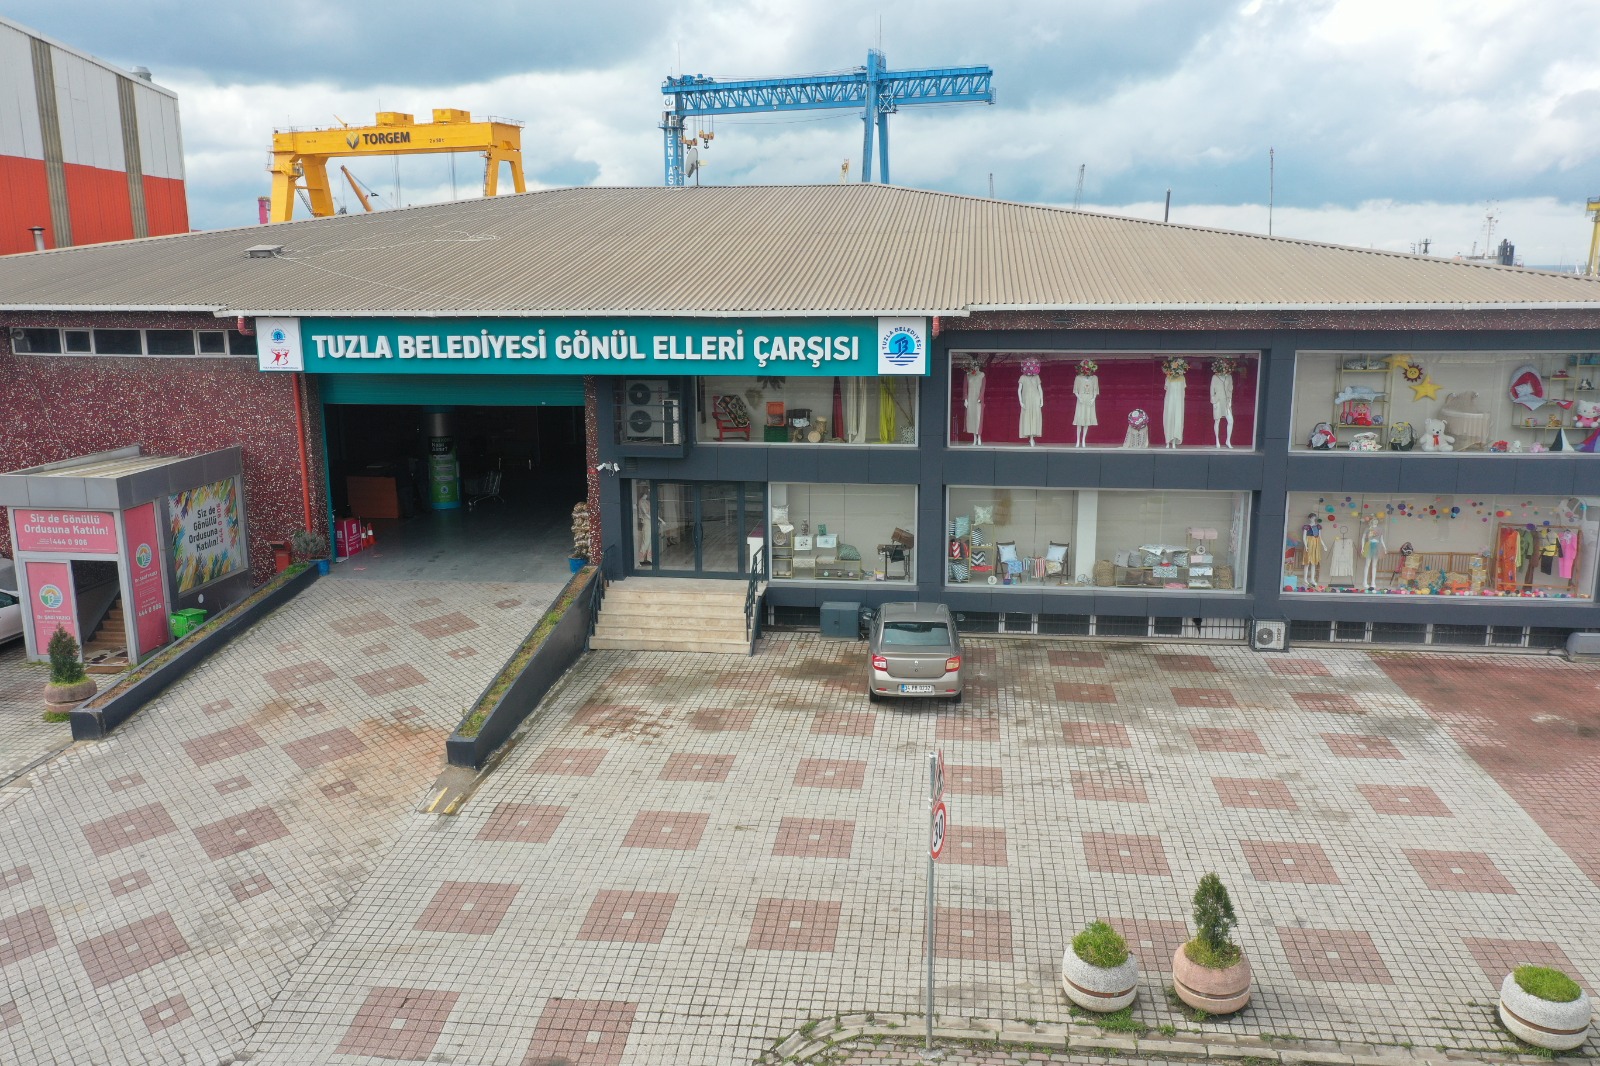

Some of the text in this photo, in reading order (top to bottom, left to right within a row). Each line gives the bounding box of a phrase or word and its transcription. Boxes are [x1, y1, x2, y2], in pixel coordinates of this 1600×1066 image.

[362, 131, 411, 145] TORGEM
[881, 330, 894, 350] TUZLA
[312, 328, 859, 368] TUZLA BELEDİYESİ GÖNÜL ELLERİ ÇARŞISI
[30, 513, 100, 525] Siz de Gönüllü
[197, 505, 216, 518] Siz de
[24, 524, 109, 535] Ordusuna Katılın!
[193, 516, 217, 531] Gönüllü
[68, 538, 73, 546] 0
[74, 538, 88, 546] 906
[188, 528, 218, 544] Ordusuna
[196, 537, 219, 552] Katılın!
[933, 814, 943, 848] 30
